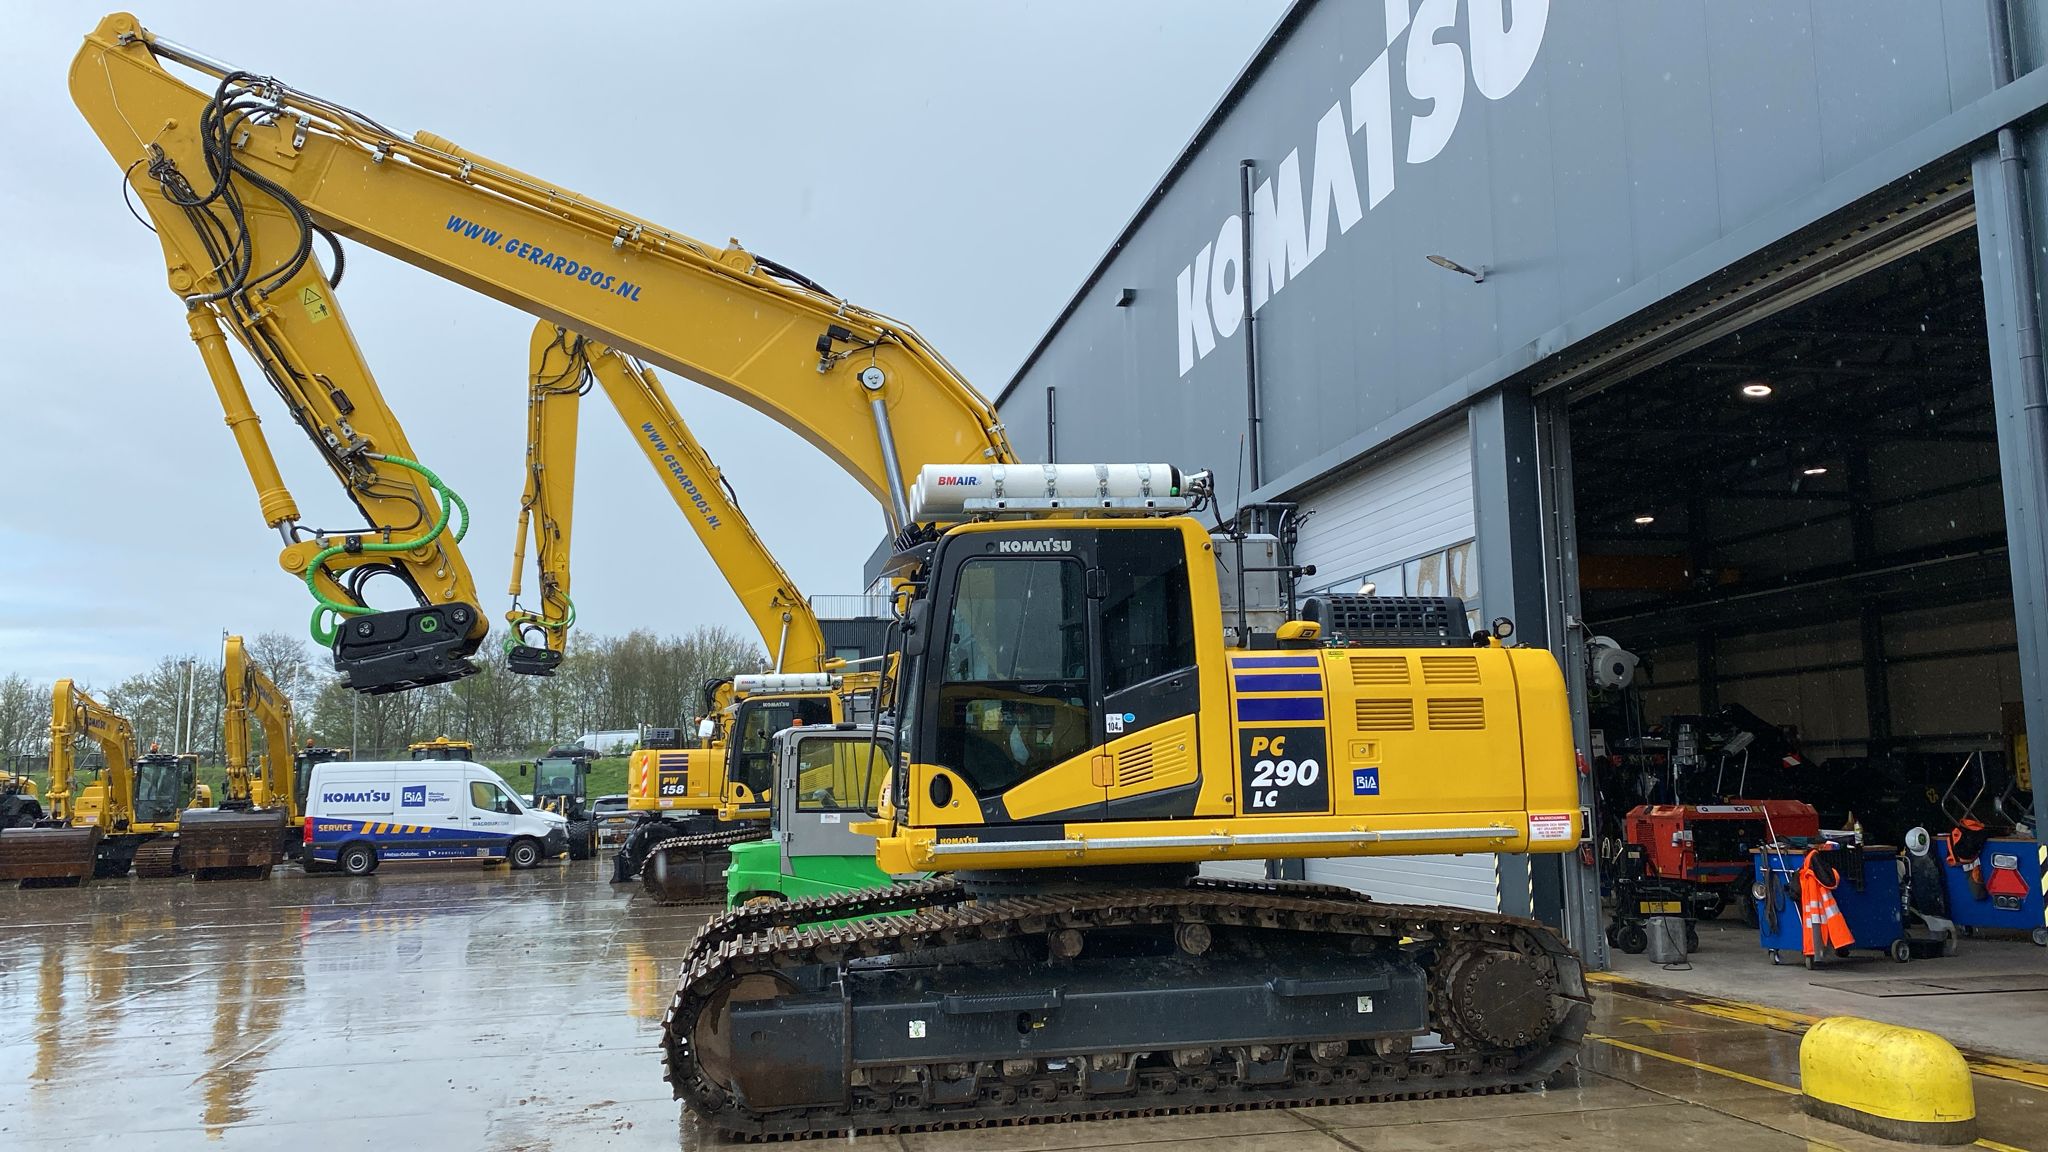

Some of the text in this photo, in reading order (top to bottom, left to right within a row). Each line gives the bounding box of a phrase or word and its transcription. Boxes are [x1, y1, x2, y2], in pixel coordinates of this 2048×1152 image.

[446, 214, 642, 302] WWW.GERARDBOS.NL
[641, 421, 722, 531] WWW.GERARDBOS.NL
[937, 476, 977, 486] BMAIR
[999, 537, 1072, 553] KOMATSU
[1250, 735, 1287, 757] PC
[1250, 758, 1320, 787] 290
[662, 776, 680, 785] PW
[323, 789, 391, 803] KOMATSU
[662, 784, 685, 795] 158
[1252, 790, 1279, 808] LC
[318, 824, 353, 832] SERVICE
[940, 835, 978, 845] KOMATSU
